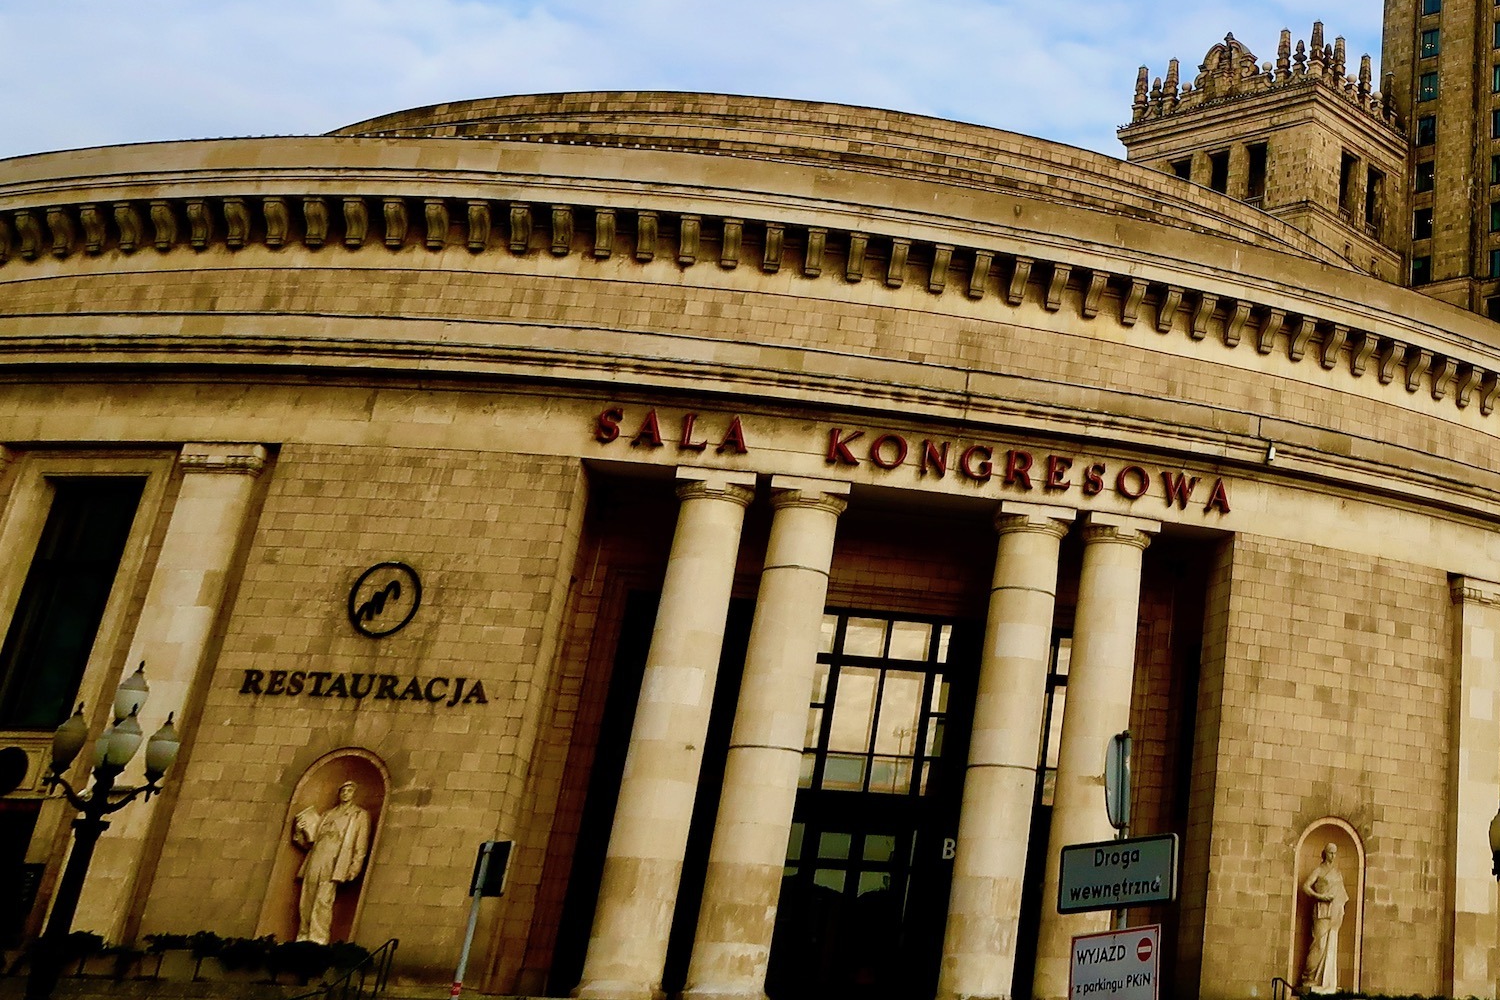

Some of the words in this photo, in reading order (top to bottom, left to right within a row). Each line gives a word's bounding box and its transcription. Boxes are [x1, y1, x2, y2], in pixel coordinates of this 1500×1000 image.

[595, 406, 748, 454] SALA
[825, 427, 1231, 513] KONGRESOWA
[238, 669, 489, 708] RESTAURACJA
[1094, 848, 1140, 869] Droga
[1076, 945, 1126, 965] WYJAZD
[1076, 984, 1082, 994] z
[1083, 978, 1123, 996] parkingu
[1126, 972, 1151, 988] PKiN
